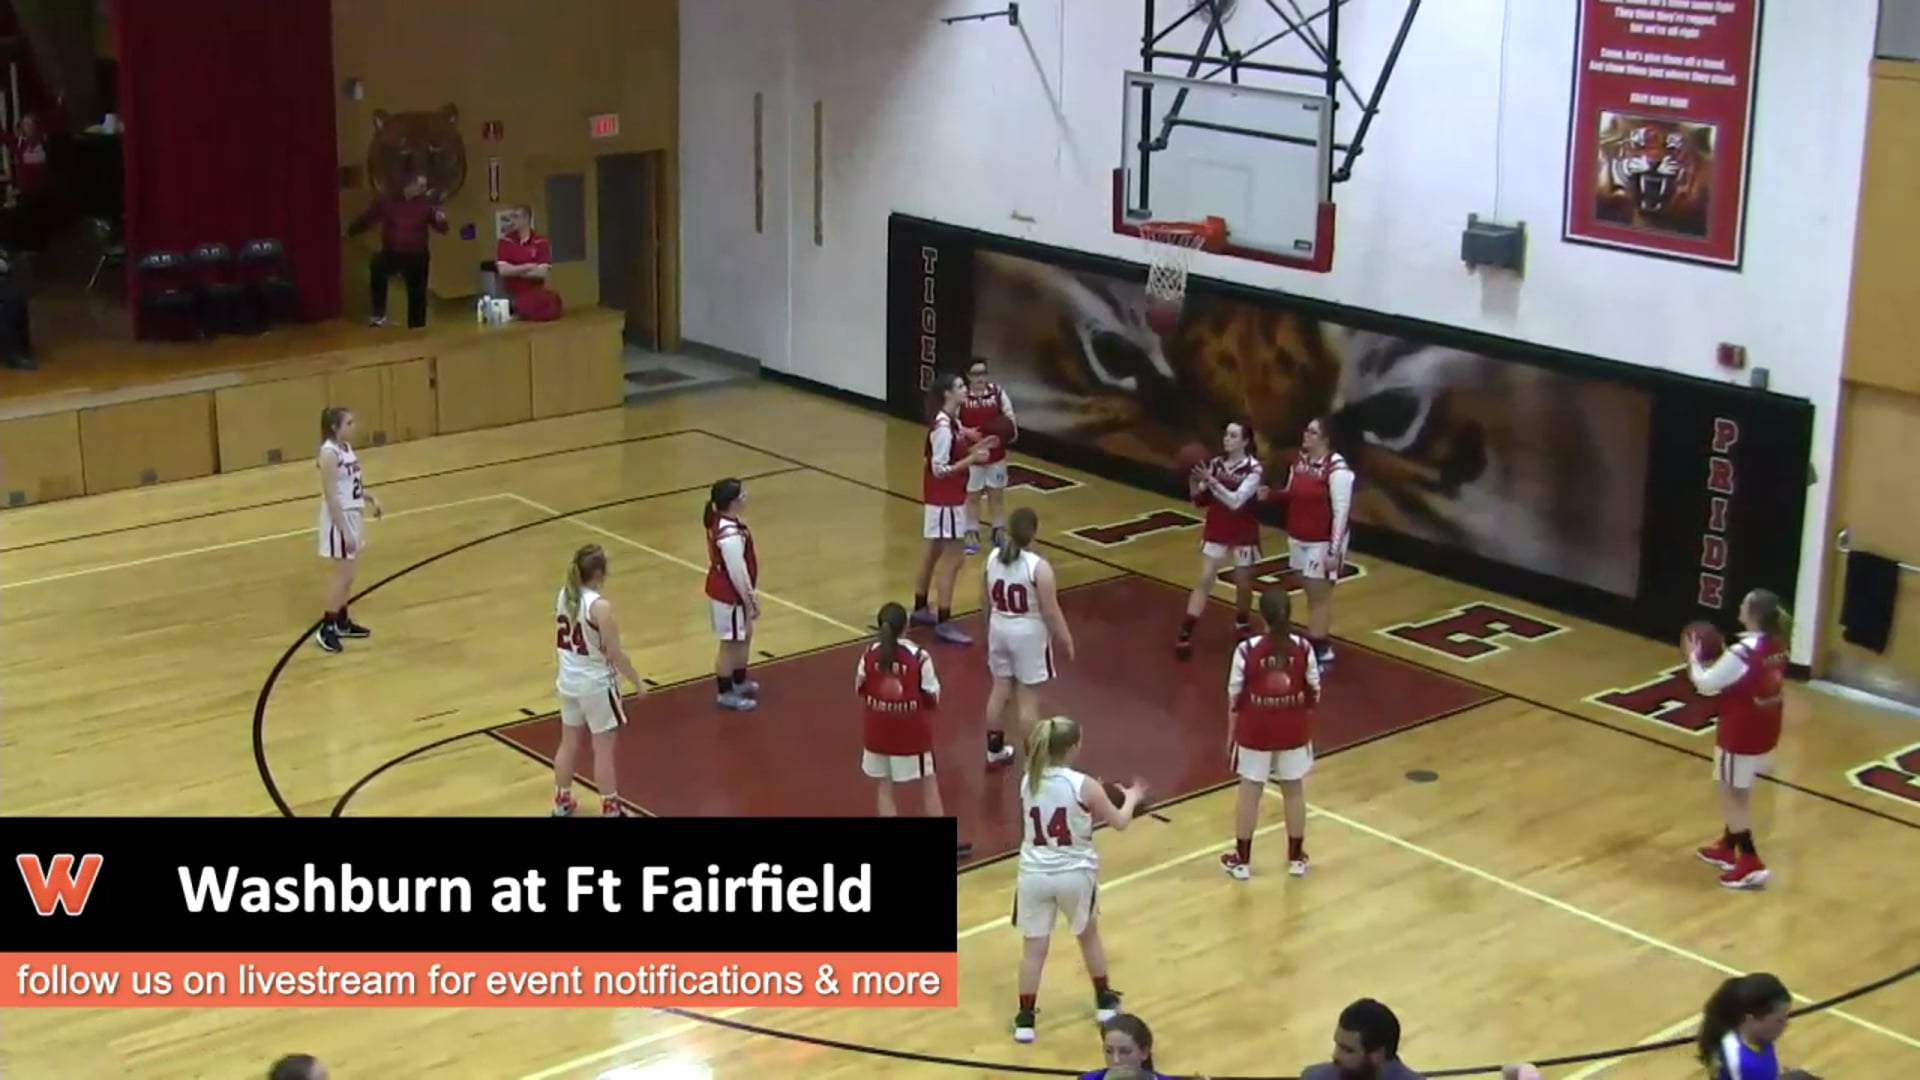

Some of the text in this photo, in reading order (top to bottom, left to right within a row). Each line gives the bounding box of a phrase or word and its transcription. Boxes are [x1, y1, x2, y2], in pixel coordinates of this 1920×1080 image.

[1698, 416, 1739, 609] PRIDE
[991, 579, 1028, 613] 40
[557, 614, 589, 656] 24
[1029, 806, 1073, 847] 14
